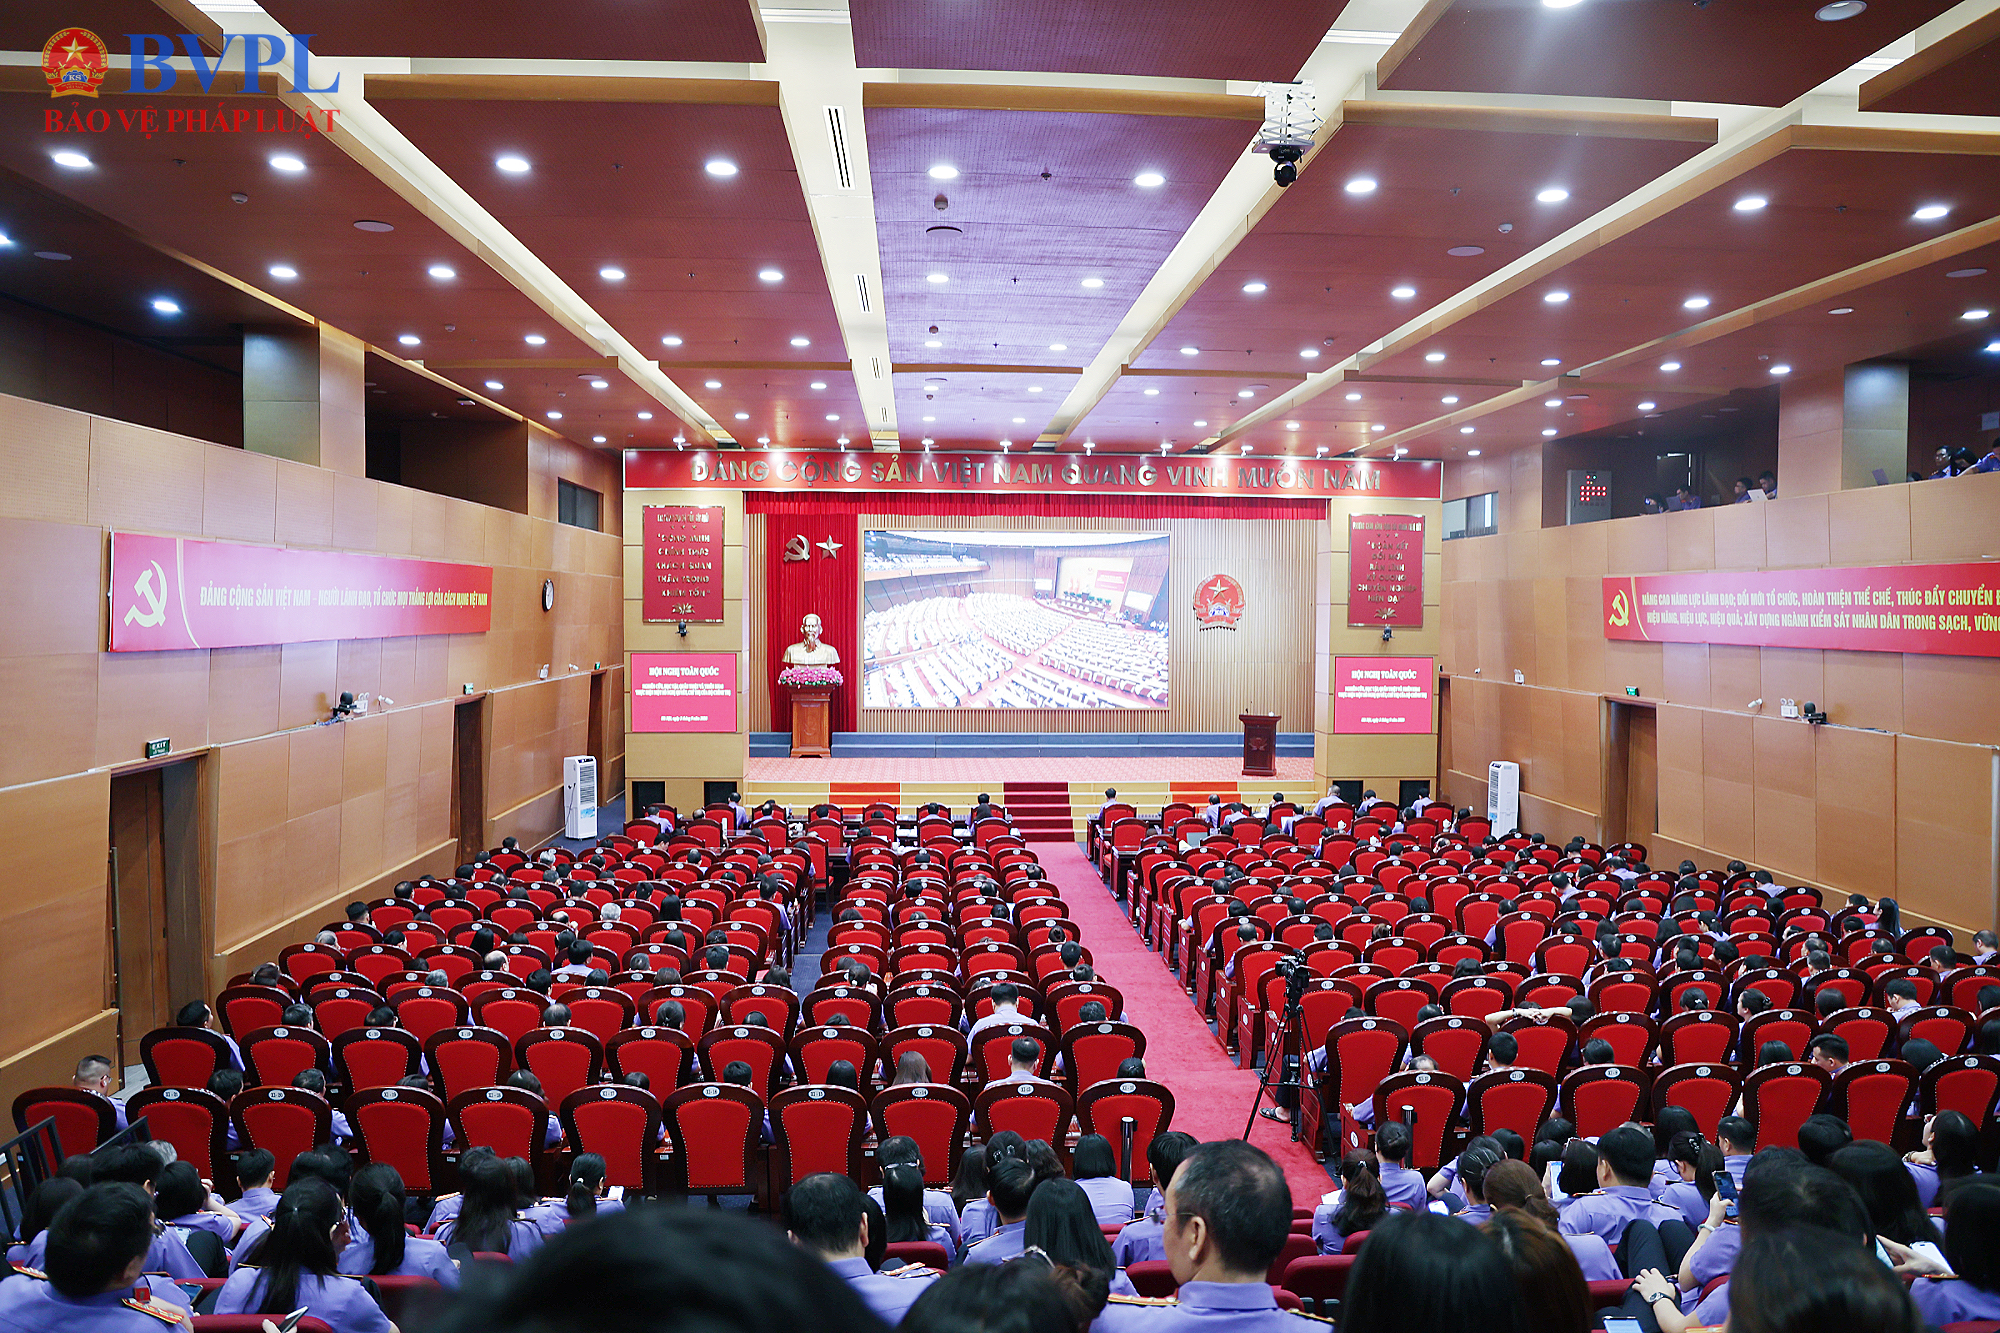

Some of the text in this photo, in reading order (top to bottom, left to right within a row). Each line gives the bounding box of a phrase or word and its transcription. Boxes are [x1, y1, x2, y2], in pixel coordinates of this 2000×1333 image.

[691, 453, 1381, 490] ĐẢNG CỘNG SẢN VIỆT NAM QUANG VINH MUÔN NĂM
[200, 580, 227, 606] ĐẢNG
[229, 584, 254, 610] CỘNG
[256, 583, 274, 606] SẢN
[276, 585, 293, 610] VIỆT
[293, 589, 311, 606] NAM
[319, 586, 340, 606] NGƯỜI
[373, 585, 382, 606] TỔ
[1658, 593, 1671, 606] CAO
[1689, 592, 1701, 608] LỰC
[1736, 588, 1750, 606] ĐỔI
[1750, 590, 1766, 606] MỚI
[1766, 588, 1777, 606] TỔ
[1777, 590, 1801, 607] CHỨC,
[1802, 589, 1825, 606] HOÀN
[1826, 588, 1852, 609] THIỆN
[1853, 585, 1871, 606] THỂ
[1872, 586, 1895, 607] CHẾ,
[1896, 587, 1923, 606] THÚC
[1924, 584, 1946, 606] ĐẨY
[1948, 583, 1993, 606] CHUYỂN
[1744, 611, 1758, 626] XÂY
[1759, 612, 1781, 629] DỰNG
[1781, 611, 1809, 627] NGÀNH
[1810, 608, 1832, 628] KIỂM
[1833, 611, 1851, 628] SÁT
[1852, 611, 1878, 629] NHÂN
[1879, 611, 1901, 629] DÂN
[1902, 614, 1936, 630] TRONG
[1938, 614, 1972, 634] SẠCH,
[152, 741, 167, 750] EXIT
